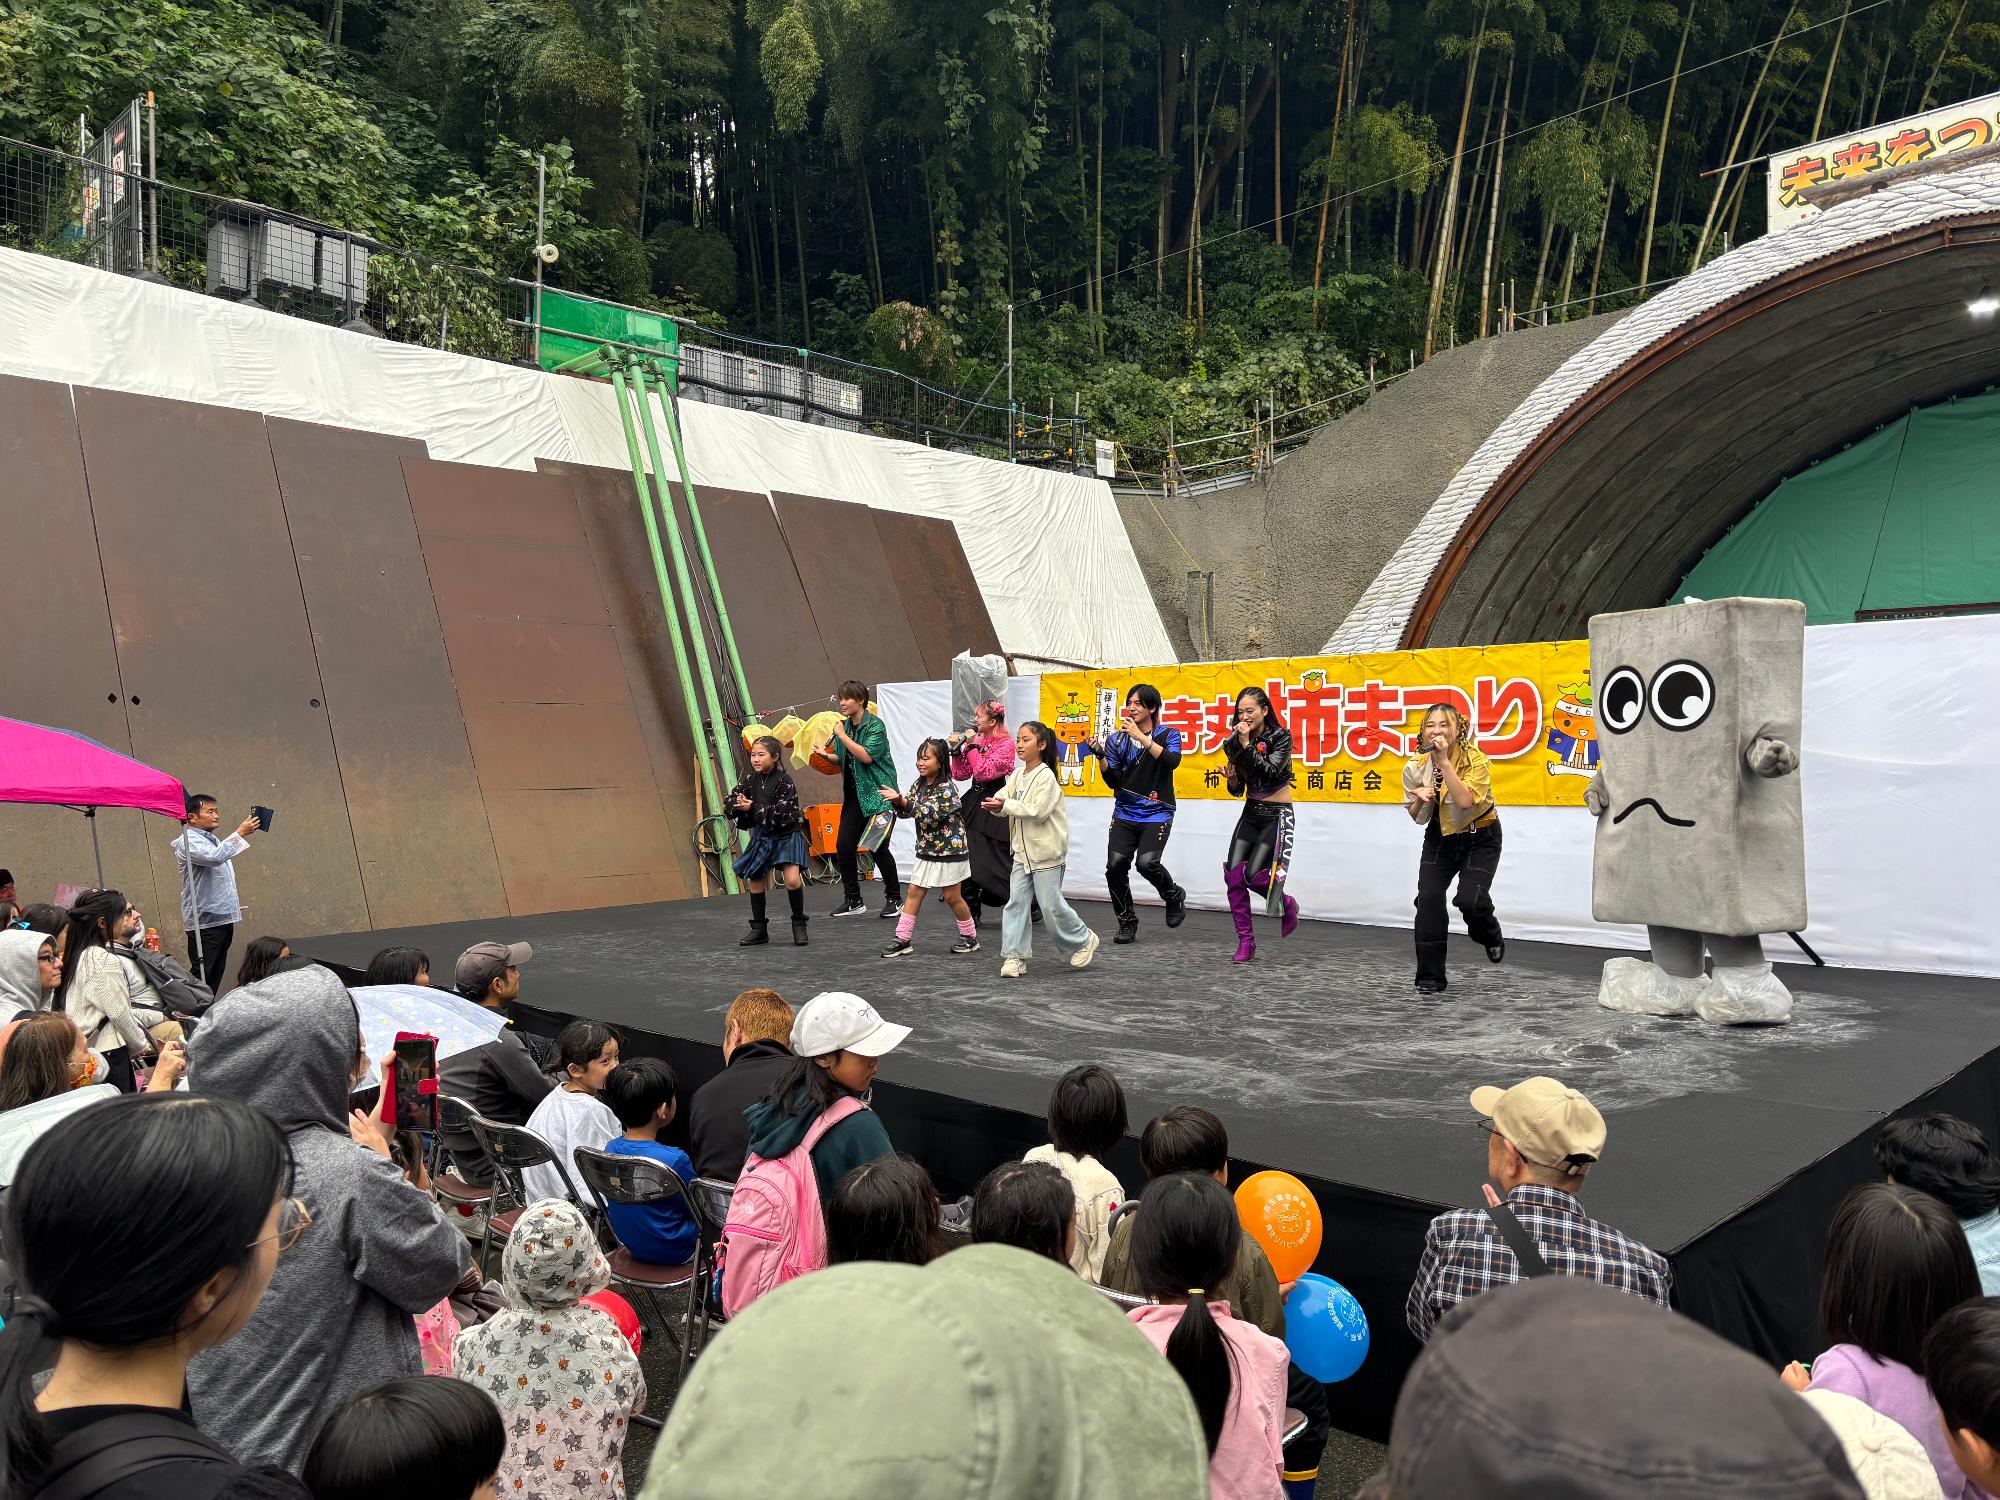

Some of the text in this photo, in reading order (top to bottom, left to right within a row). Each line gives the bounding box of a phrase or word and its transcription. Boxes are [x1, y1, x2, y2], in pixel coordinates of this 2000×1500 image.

[1780, 116, 2000, 207] 未来をつ
[1120, 676, 1543, 766] 寺丸柿まつり
